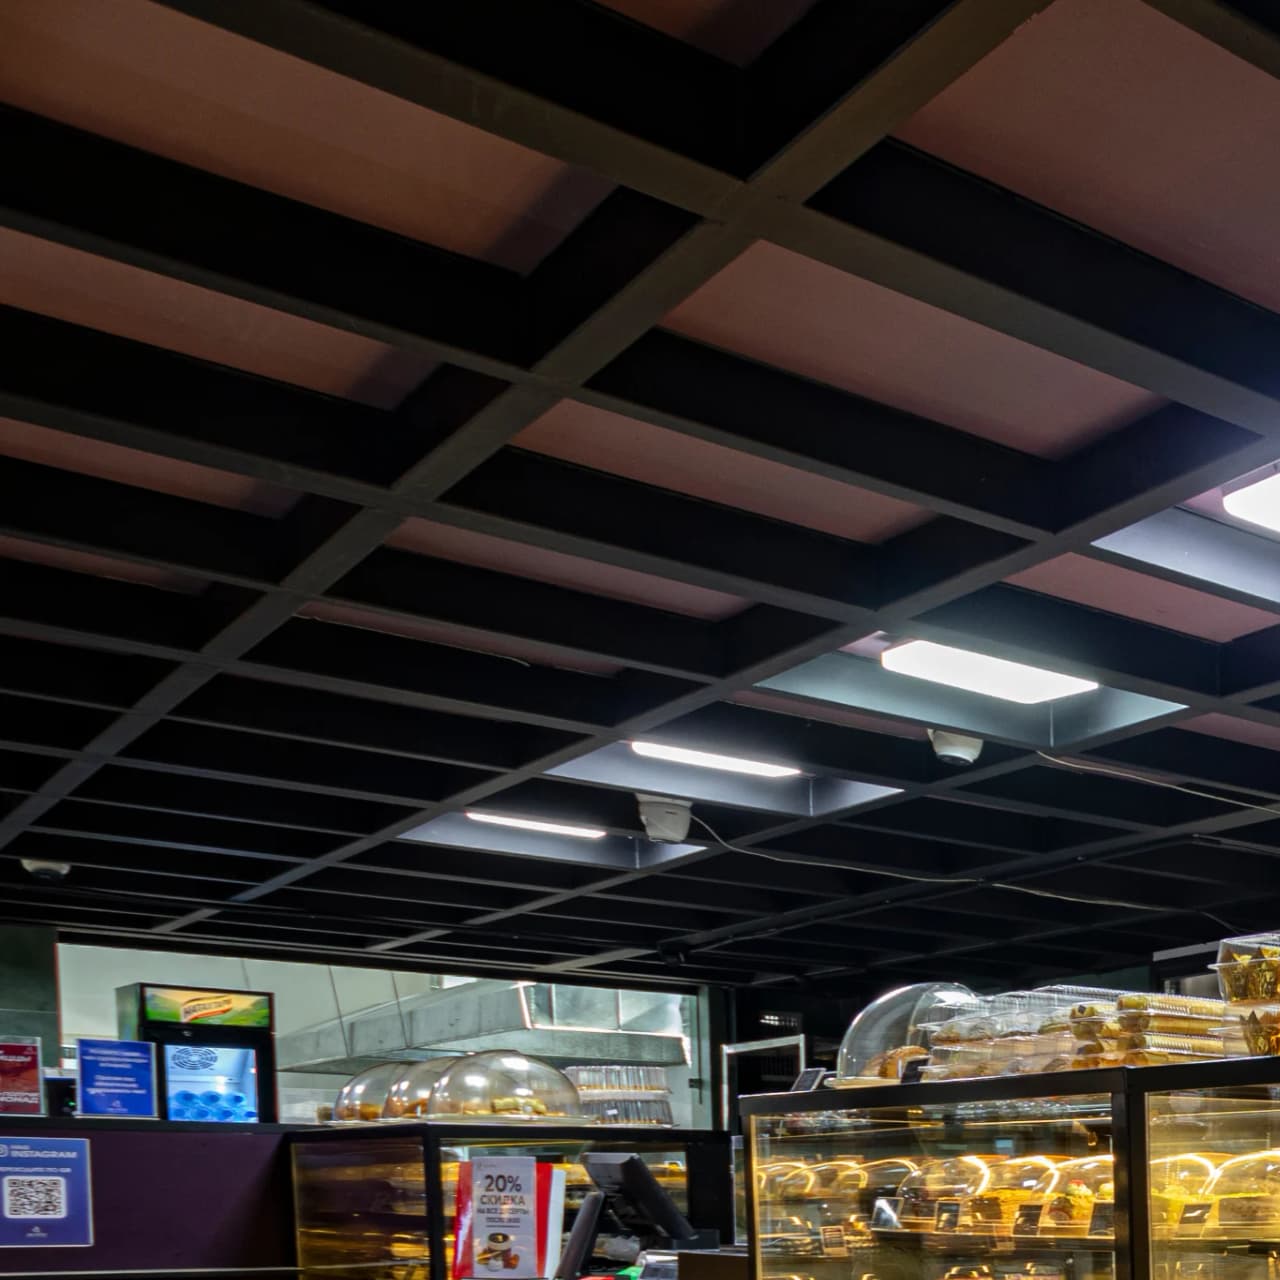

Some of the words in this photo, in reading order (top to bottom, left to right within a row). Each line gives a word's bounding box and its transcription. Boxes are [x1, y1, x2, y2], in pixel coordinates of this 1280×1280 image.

[10, 1150, 78, 1158] INSTAGRAM
[484, 1174, 523, 1193] 20%
[480, 1194, 526, 1206] СКИДКА
